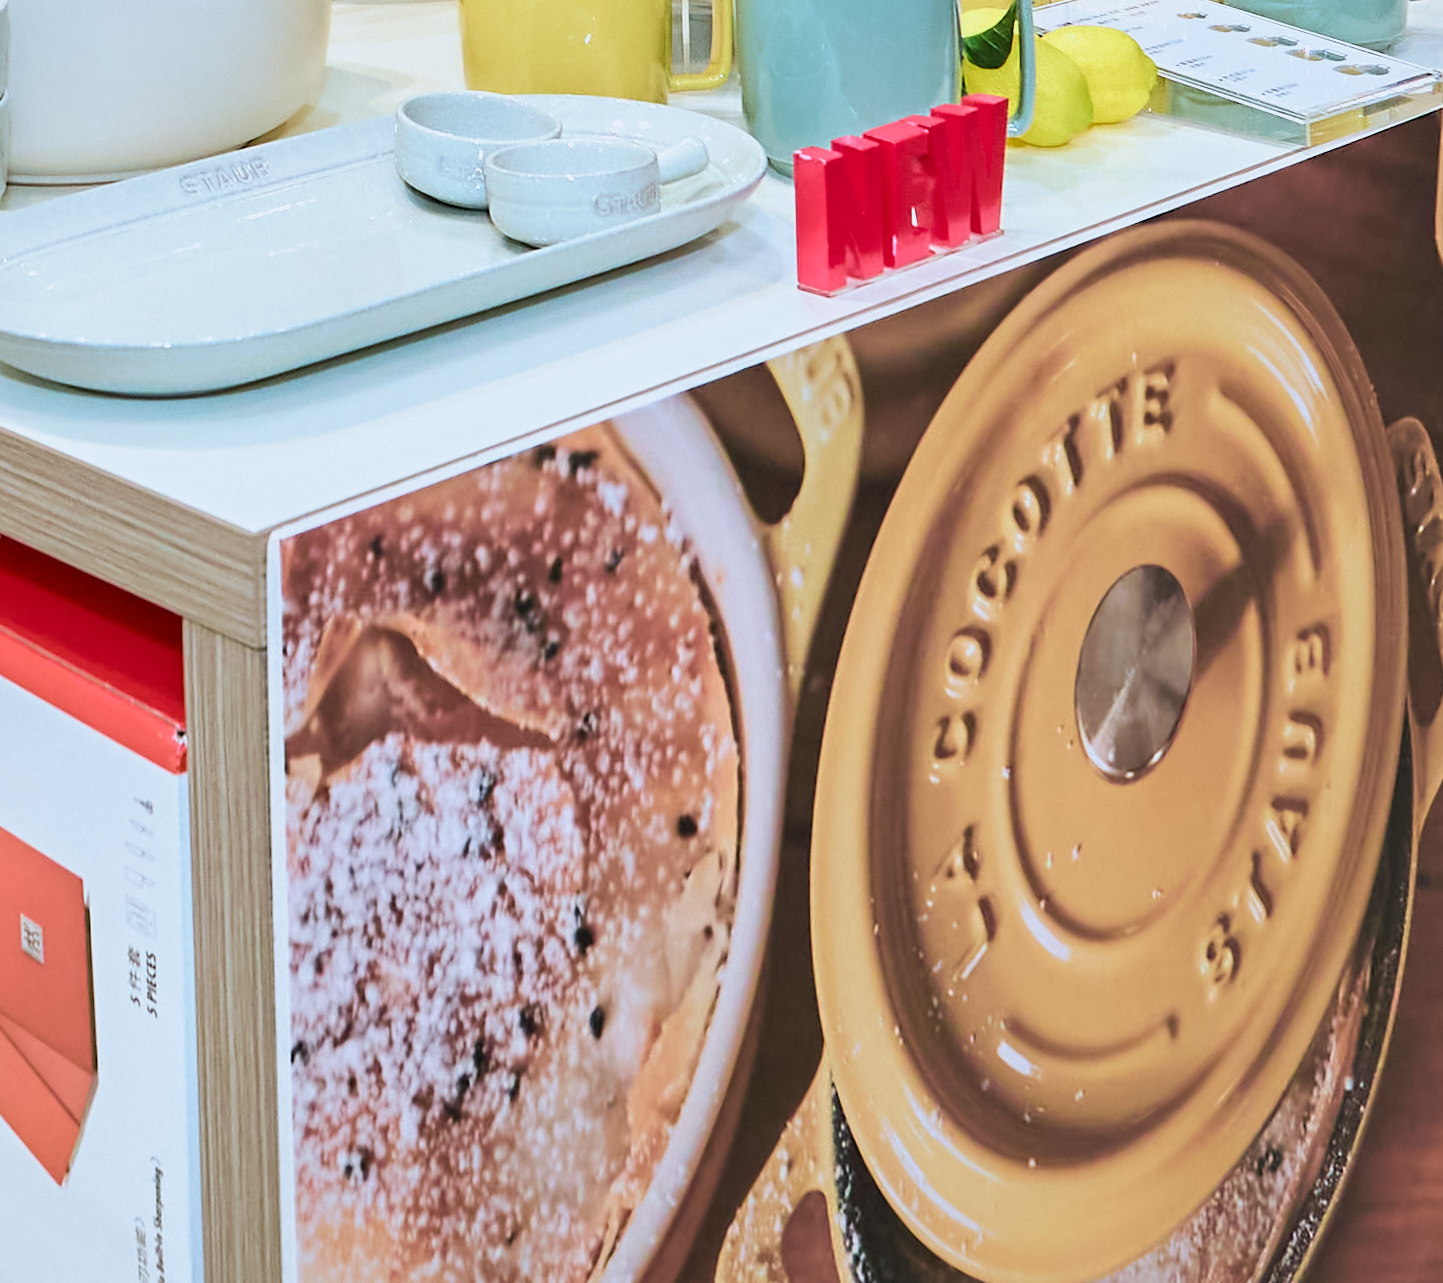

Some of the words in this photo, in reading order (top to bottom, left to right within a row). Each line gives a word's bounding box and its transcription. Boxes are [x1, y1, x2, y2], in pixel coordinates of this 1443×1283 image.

[180, 157, 271, 194] STAUB
[794, 94, 1008, 296] NEW
[929, 359, 1177, 775] COCOTTE
[1198, 619, 1337, 997] STAUB
[146, 951, 157, 1003] PIECES
[146, 1006, 158, 1019] 5
